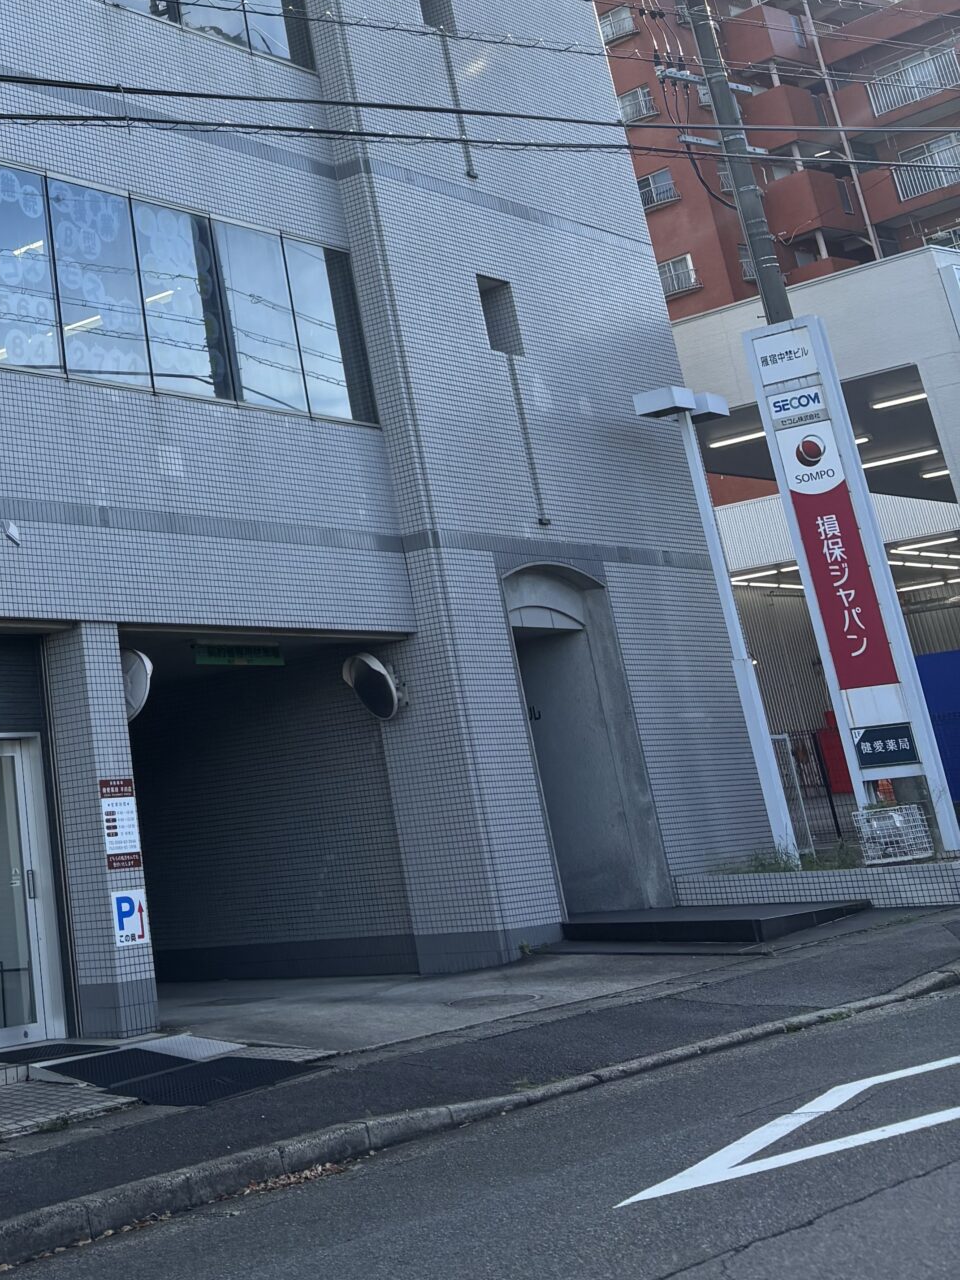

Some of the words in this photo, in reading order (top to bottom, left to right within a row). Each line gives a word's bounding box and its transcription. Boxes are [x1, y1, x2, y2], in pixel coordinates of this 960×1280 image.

[773, 392, 821, 413] SECOM
[781, 412, 821, 426] セコム株式会社
[795, 468, 835, 485] SOMPO
[816, 514, 867, 657] 損保ジャパン
[860, 738, 910, 754] 健愛薬局
[116, 896, 135, 931] P
